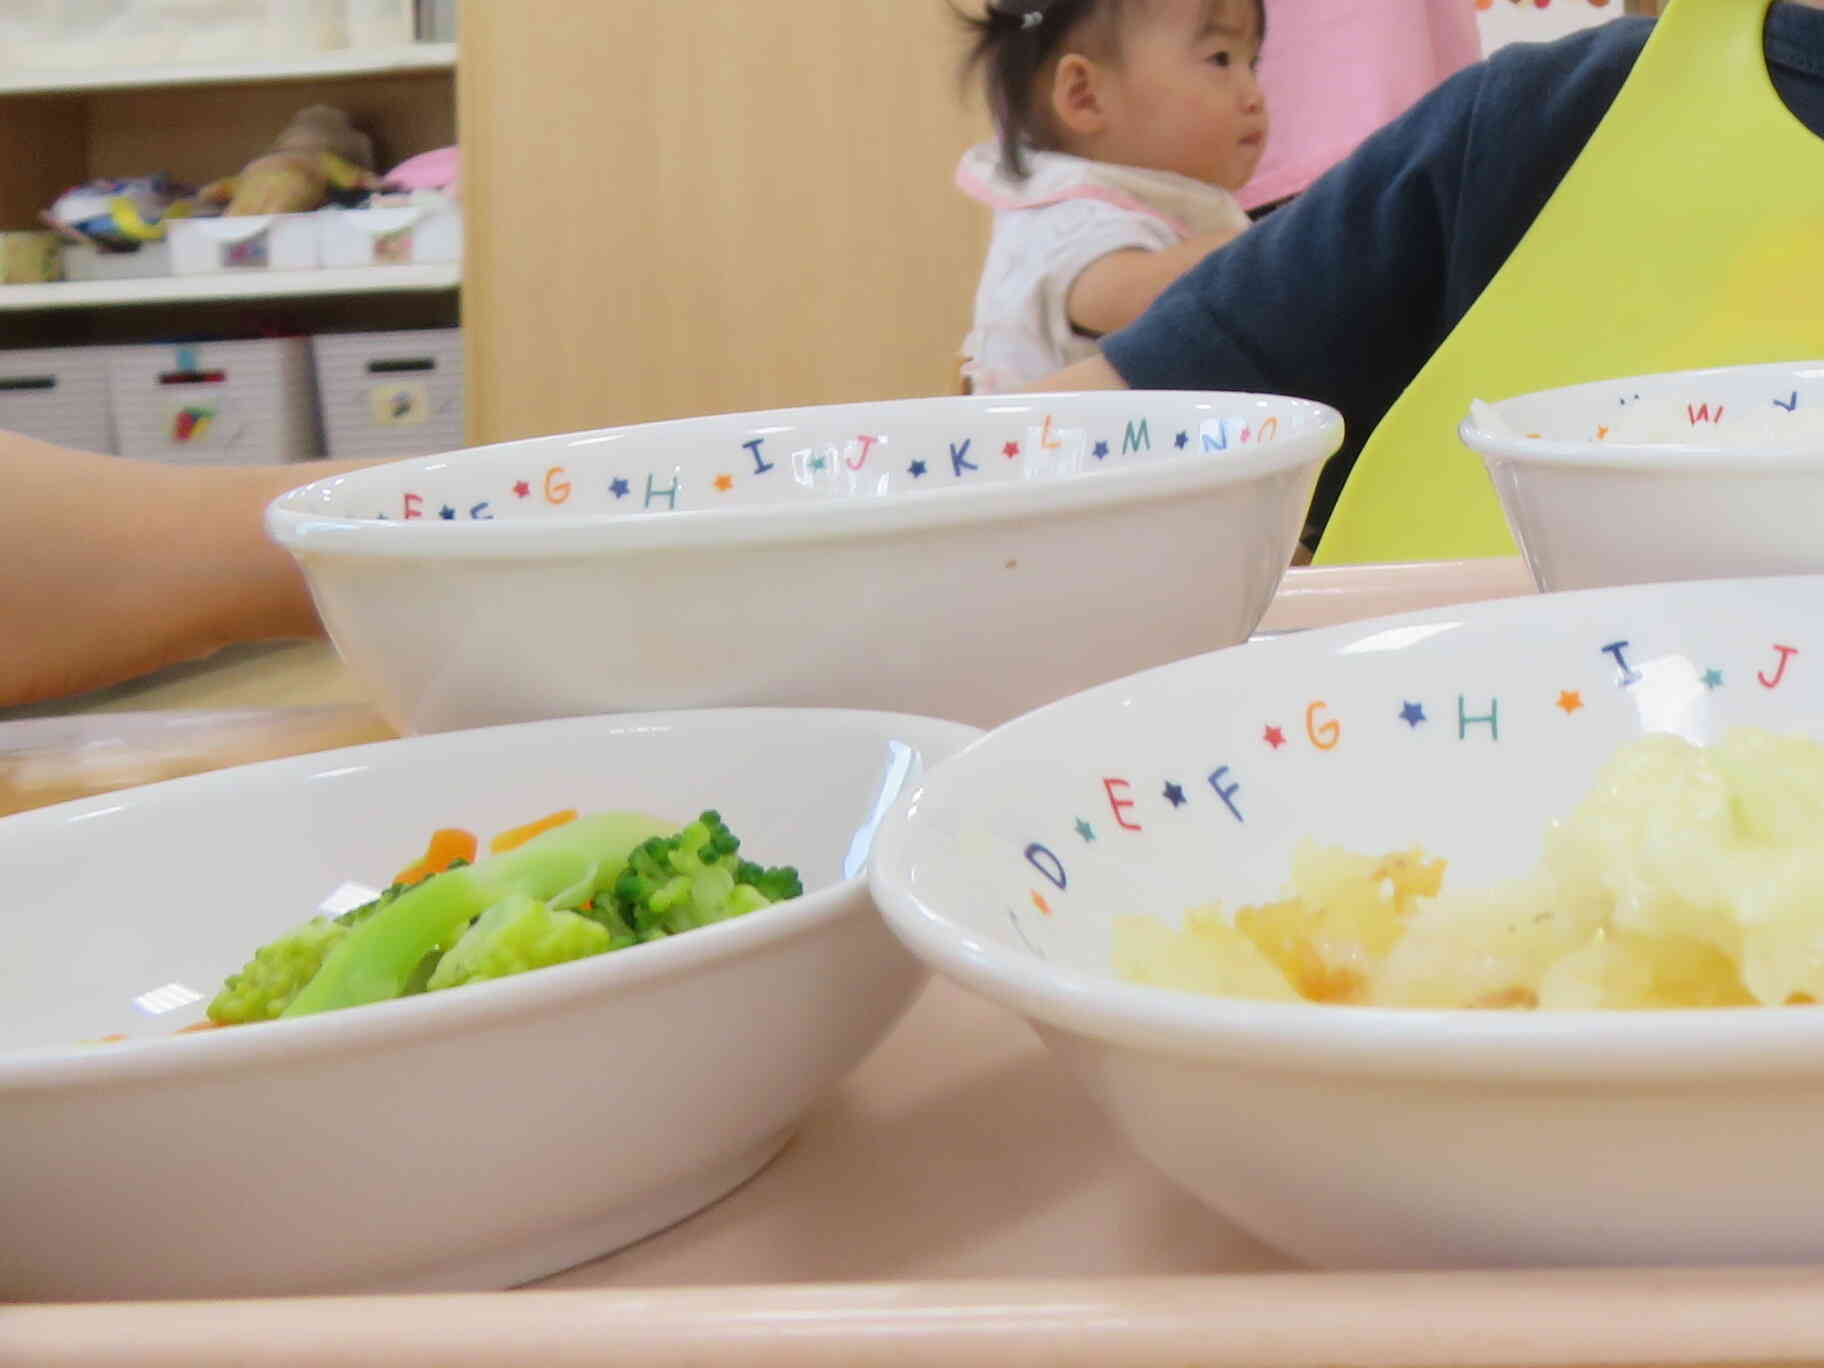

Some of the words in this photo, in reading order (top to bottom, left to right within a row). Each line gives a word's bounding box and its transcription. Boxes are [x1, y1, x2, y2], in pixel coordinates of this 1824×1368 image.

[543, 466, 572, 505] G
[643, 472, 679, 511] H
[742, 437, 776, 475] I
[845, 434, 878, 472] J
[948, 438, 980, 477] K
[1039, 415, 1063, 450] L
[1121, 417, 1152, 456] M
[1024, 842, 1067, 890] D
[1102, 777, 1143, 832] E
[1206, 764, 1245, 824] F
[1305, 699, 1342, 751] G
[1457, 694, 1499, 742] H
[1600, 639, 1643, 688] I
[1756, 643, 1799, 689] J
